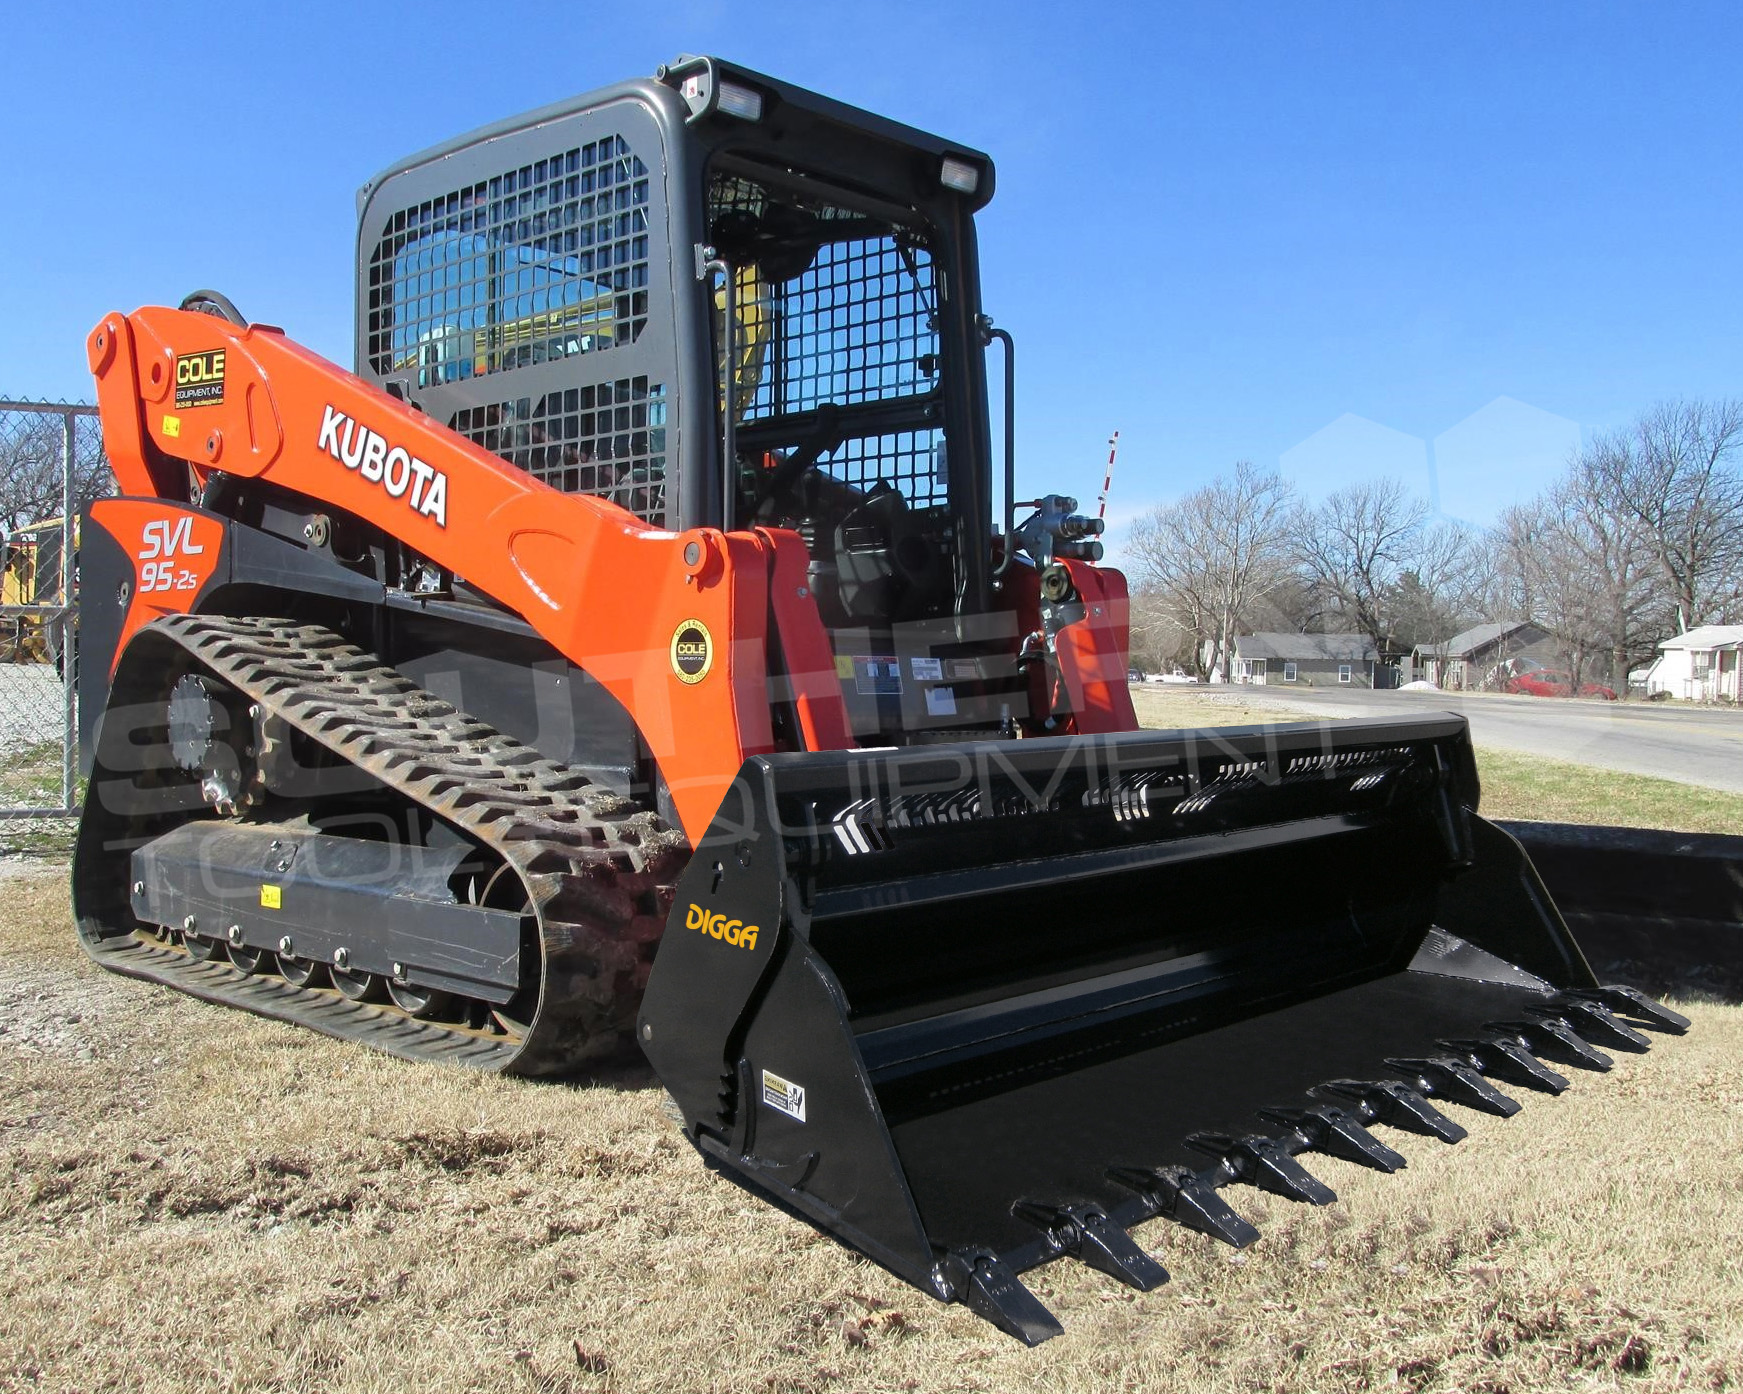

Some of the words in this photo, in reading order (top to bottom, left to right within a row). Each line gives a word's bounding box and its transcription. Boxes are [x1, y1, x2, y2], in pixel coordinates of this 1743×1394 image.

[177, 354, 225, 384] COLE
[176, 387, 211, 399] EQUIPMENT,
[318, 404, 447, 528] KUBOTA
[138, 516, 204, 560] SVL
[677, 643, 706, 654] COLE
[685, 903, 760, 951] DIGGA
